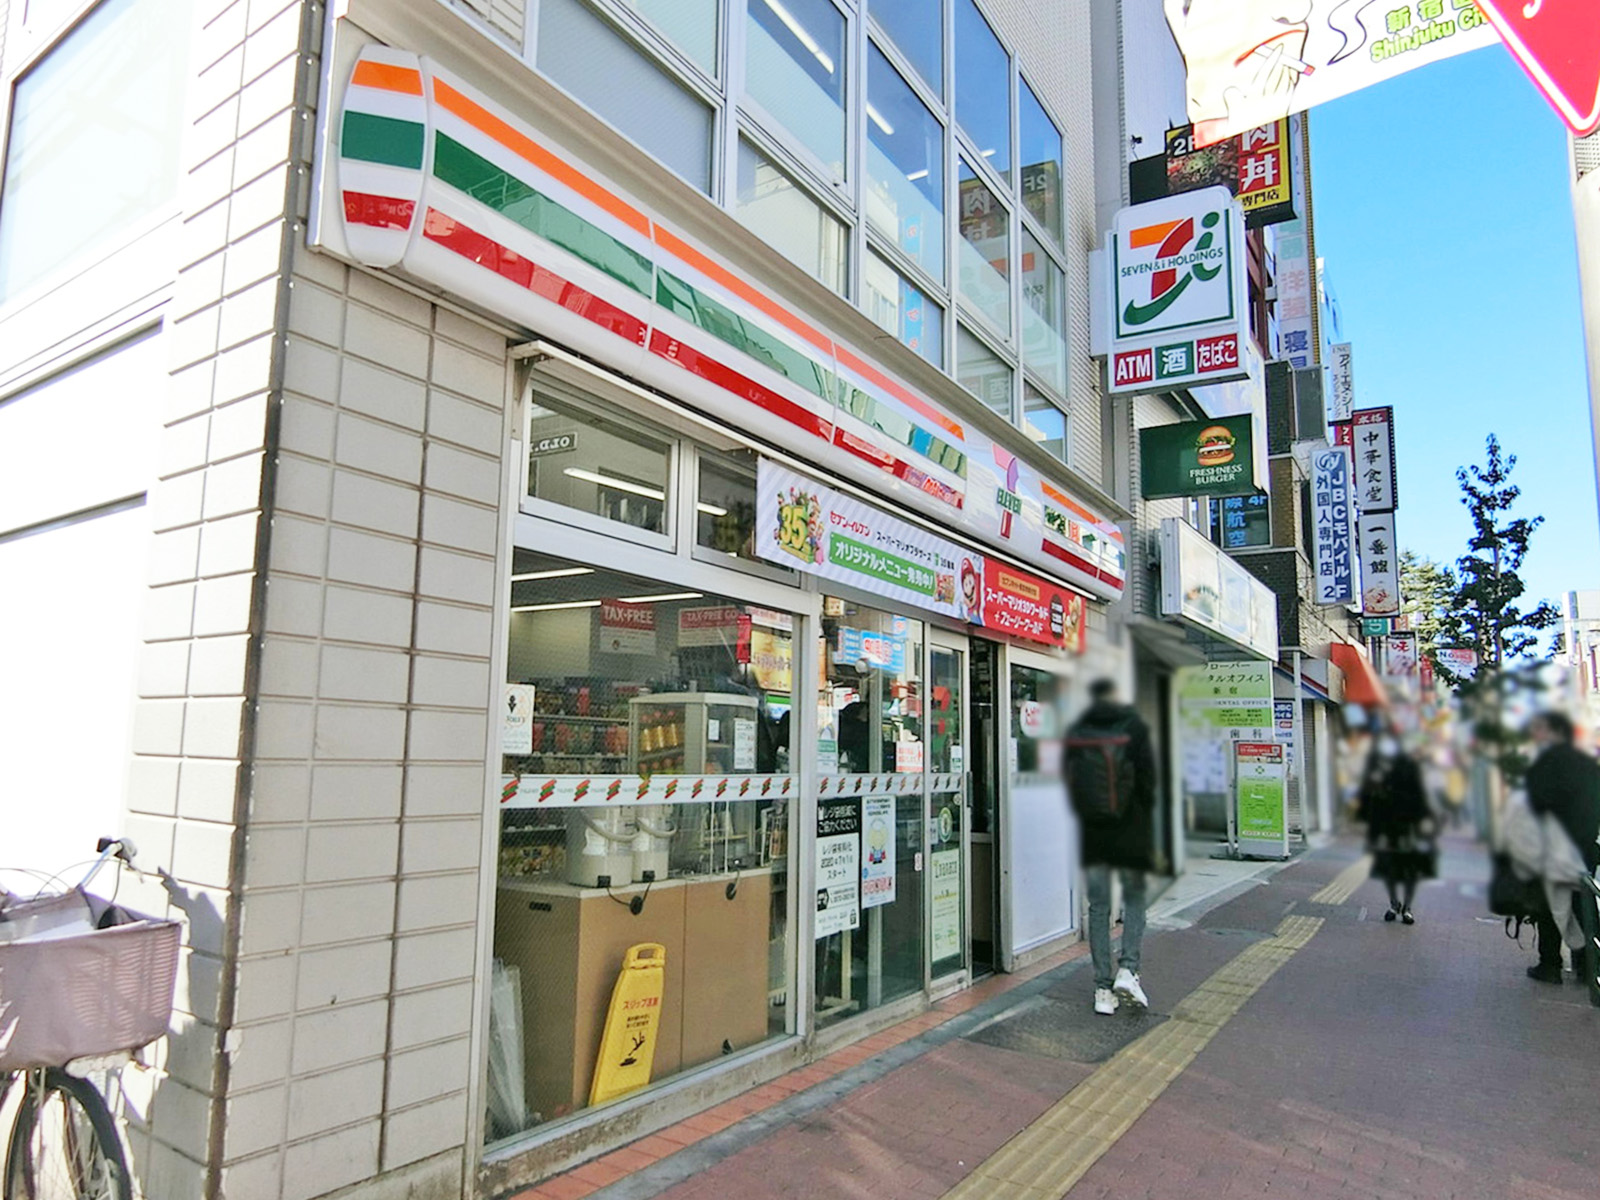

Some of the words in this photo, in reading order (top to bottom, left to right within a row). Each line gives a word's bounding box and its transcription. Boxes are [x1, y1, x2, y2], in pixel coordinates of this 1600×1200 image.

[1370, 20, 1456, 63] Shinjuku
[1168, 247, 1224, 268] HOLDINGS
[1116, 354, 1151, 382] ATM
[1162, 346, 1188, 375] 酒
[1198, 339, 1238, 368] たばこ
[1189, 463, 1243, 478] FRESHNESS
[1195, 473, 1236, 485] BURGER
[1362, 430, 1383, 503] 中華食堂
[1316, 475, 1333, 577] 外国人専門店
